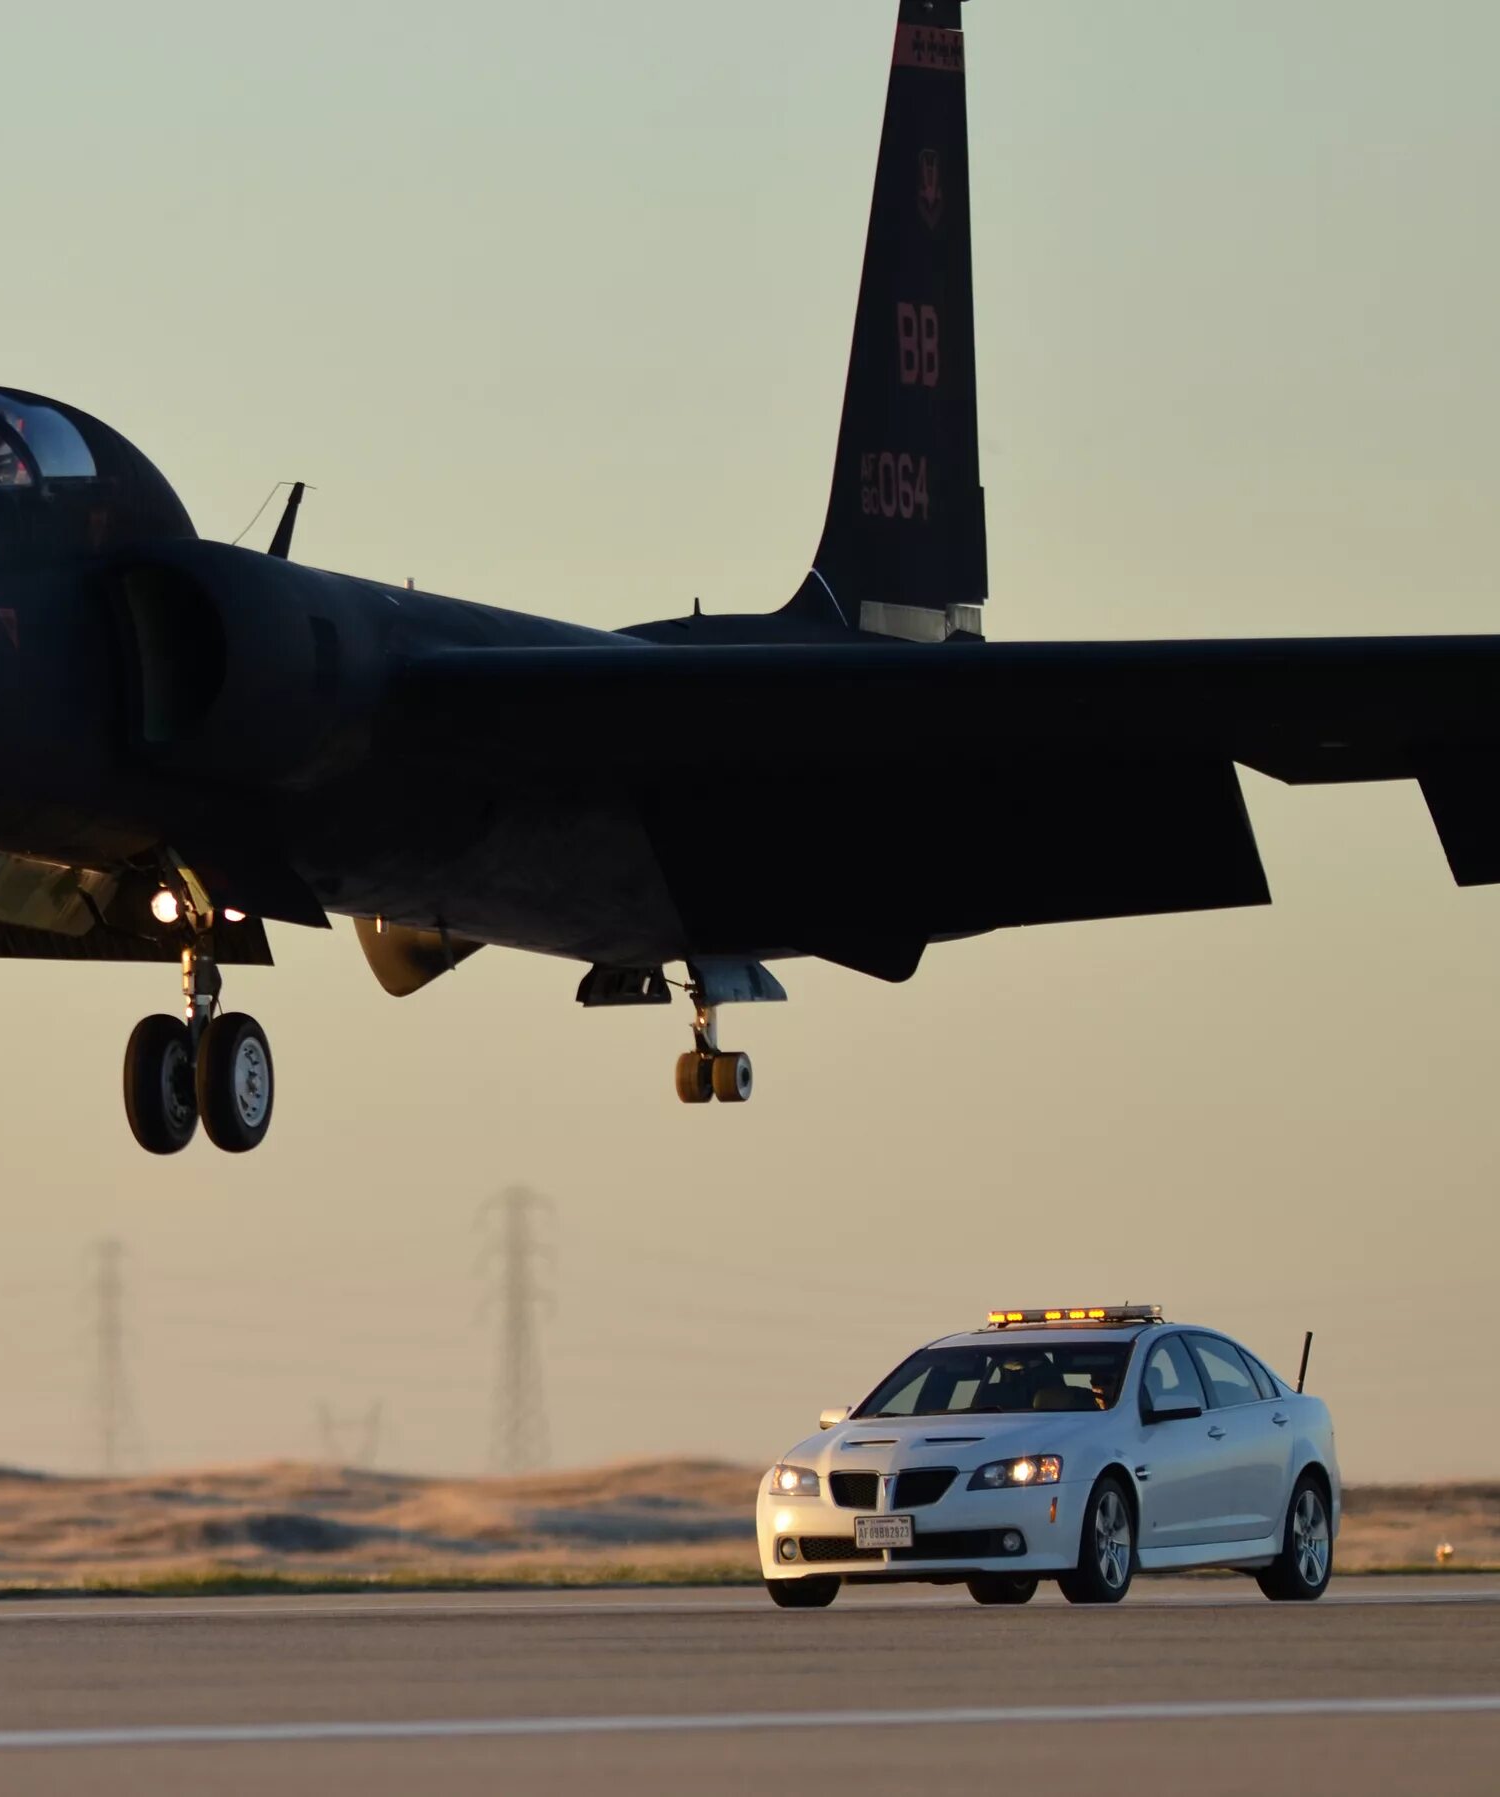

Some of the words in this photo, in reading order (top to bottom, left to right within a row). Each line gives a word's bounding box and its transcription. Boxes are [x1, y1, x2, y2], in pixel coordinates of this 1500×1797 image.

[897, 302, 938, 387] BB
[861, 453, 876, 480] AF
[879, 451, 929, 520] 064
[861, 486, 878, 514] 80
